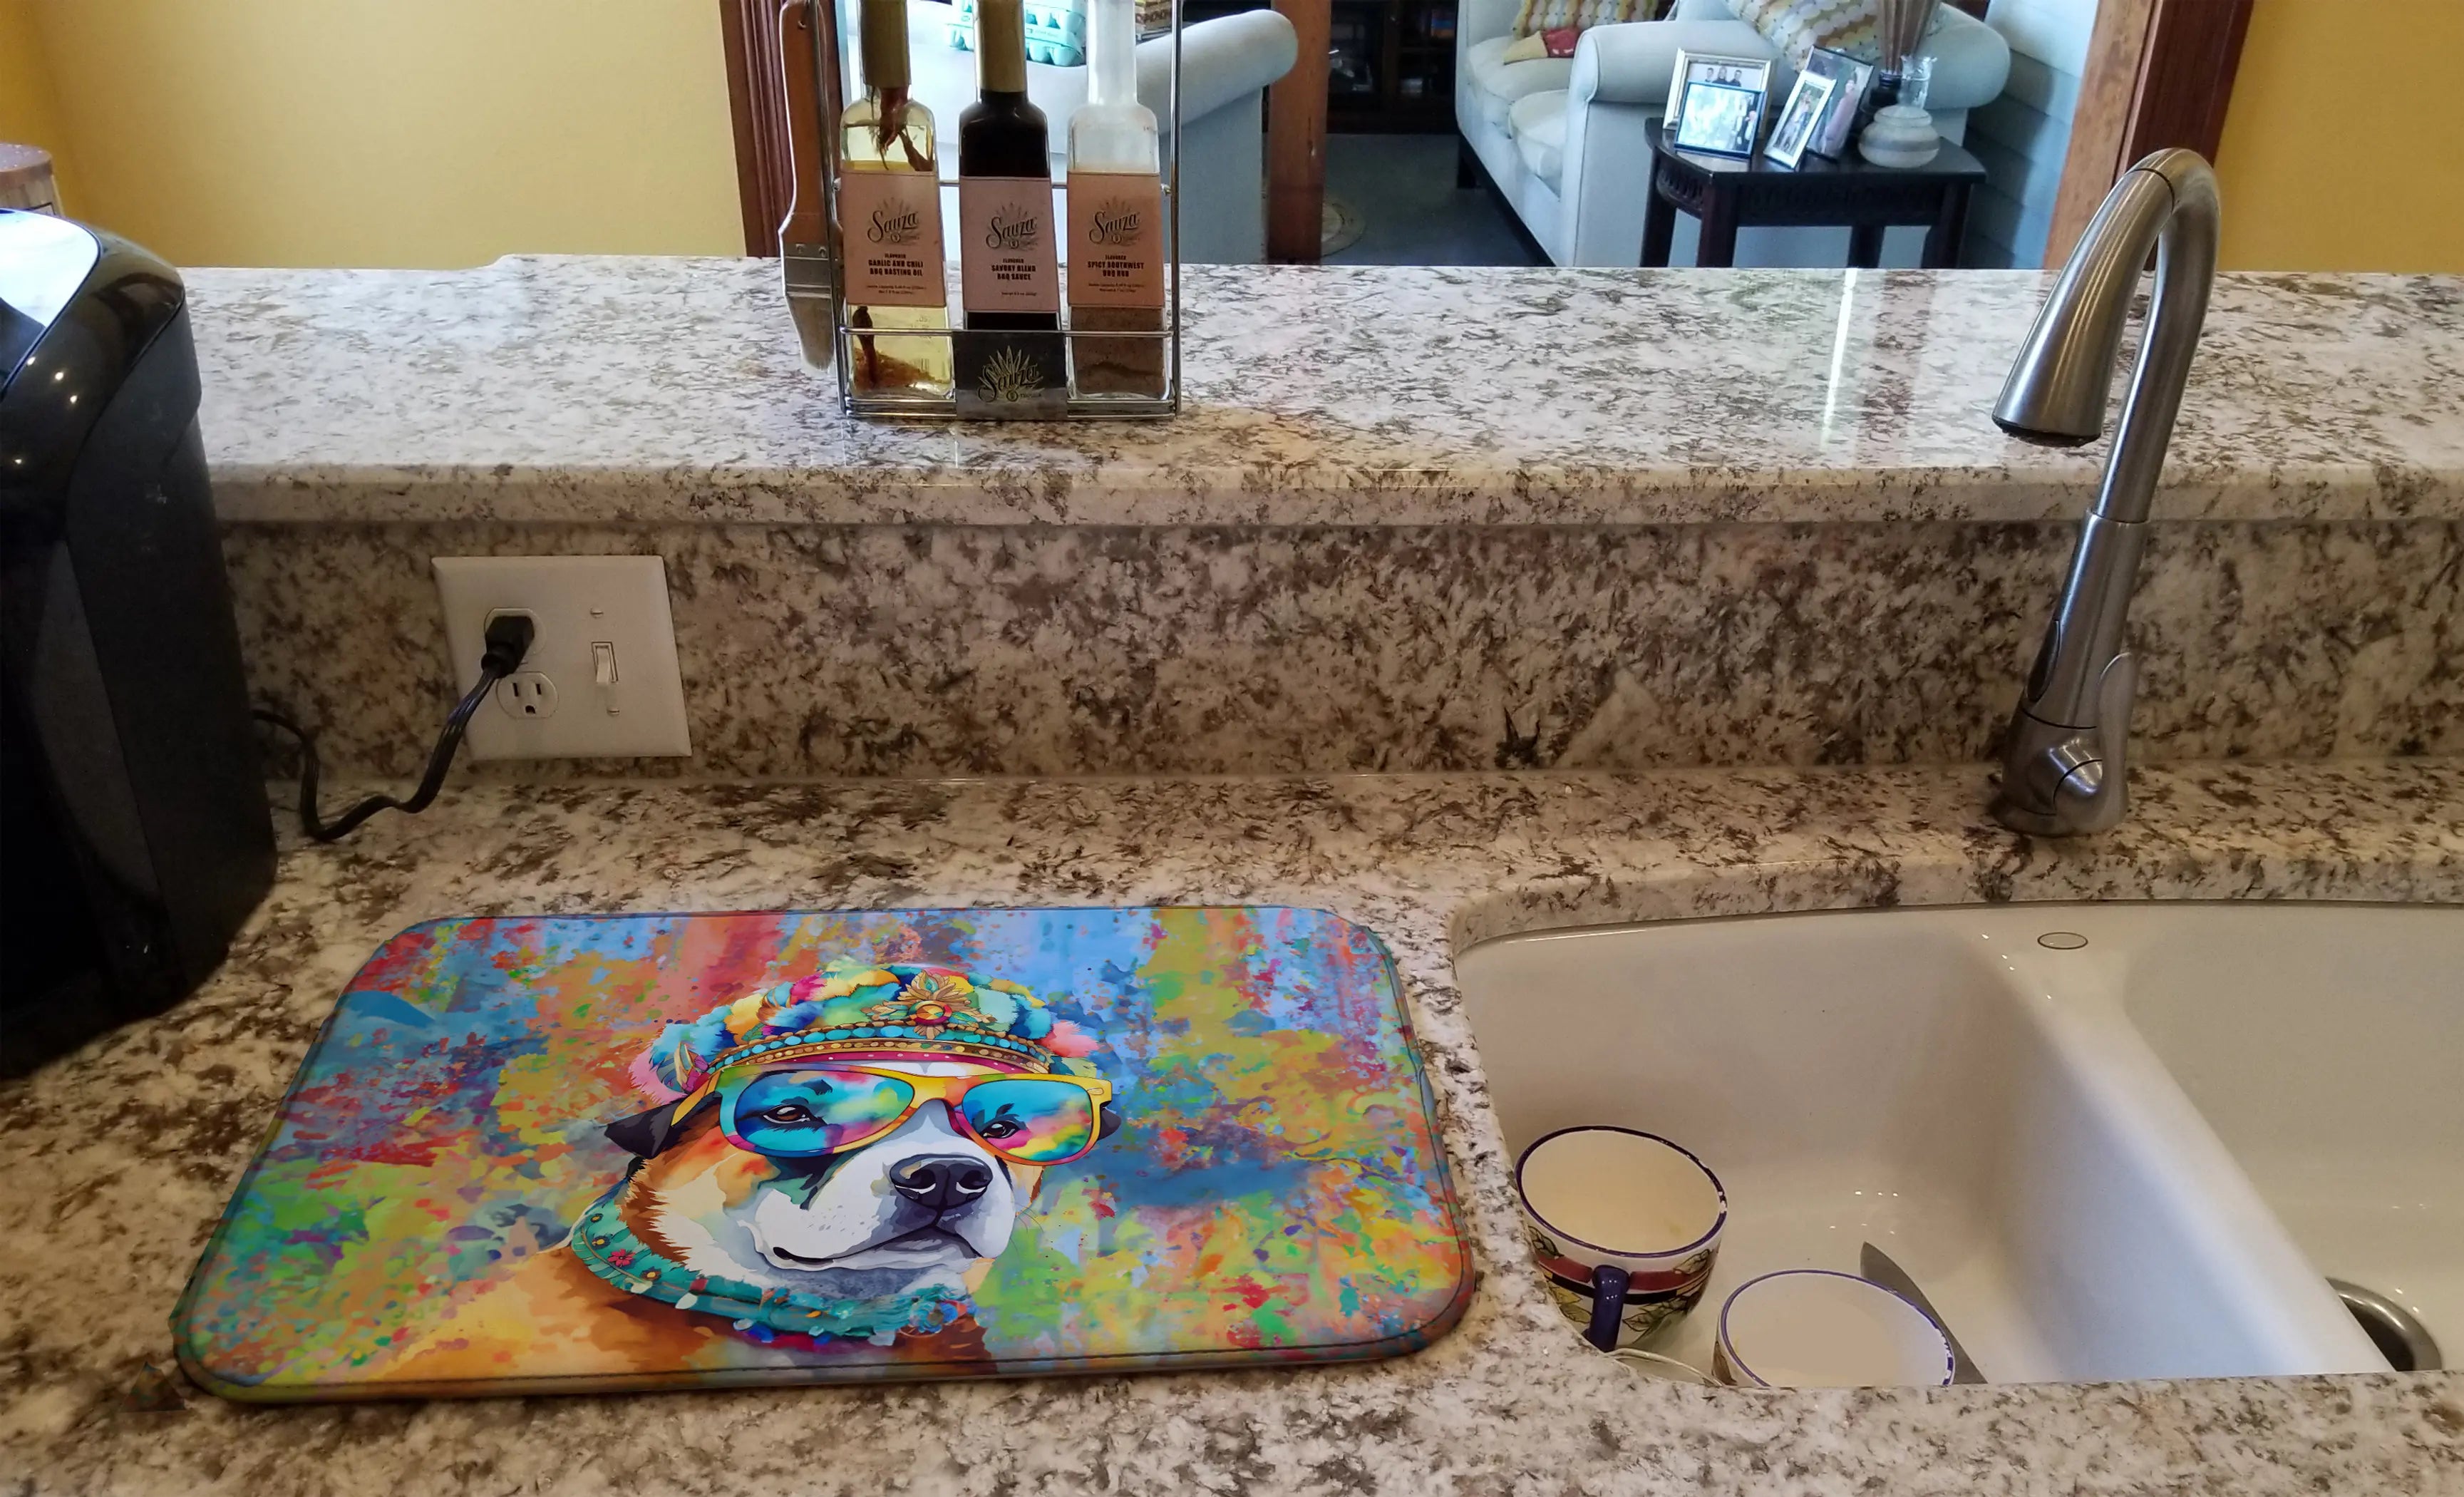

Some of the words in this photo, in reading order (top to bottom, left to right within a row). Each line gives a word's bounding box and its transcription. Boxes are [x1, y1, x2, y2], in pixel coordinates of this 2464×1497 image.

[867, 210, 919, 242] Sauza
[986, 216, 1036, 249] Sauza
[1089, 211, 1140, 244] Sauza
[977, 363, 1040, 403] Sauza
